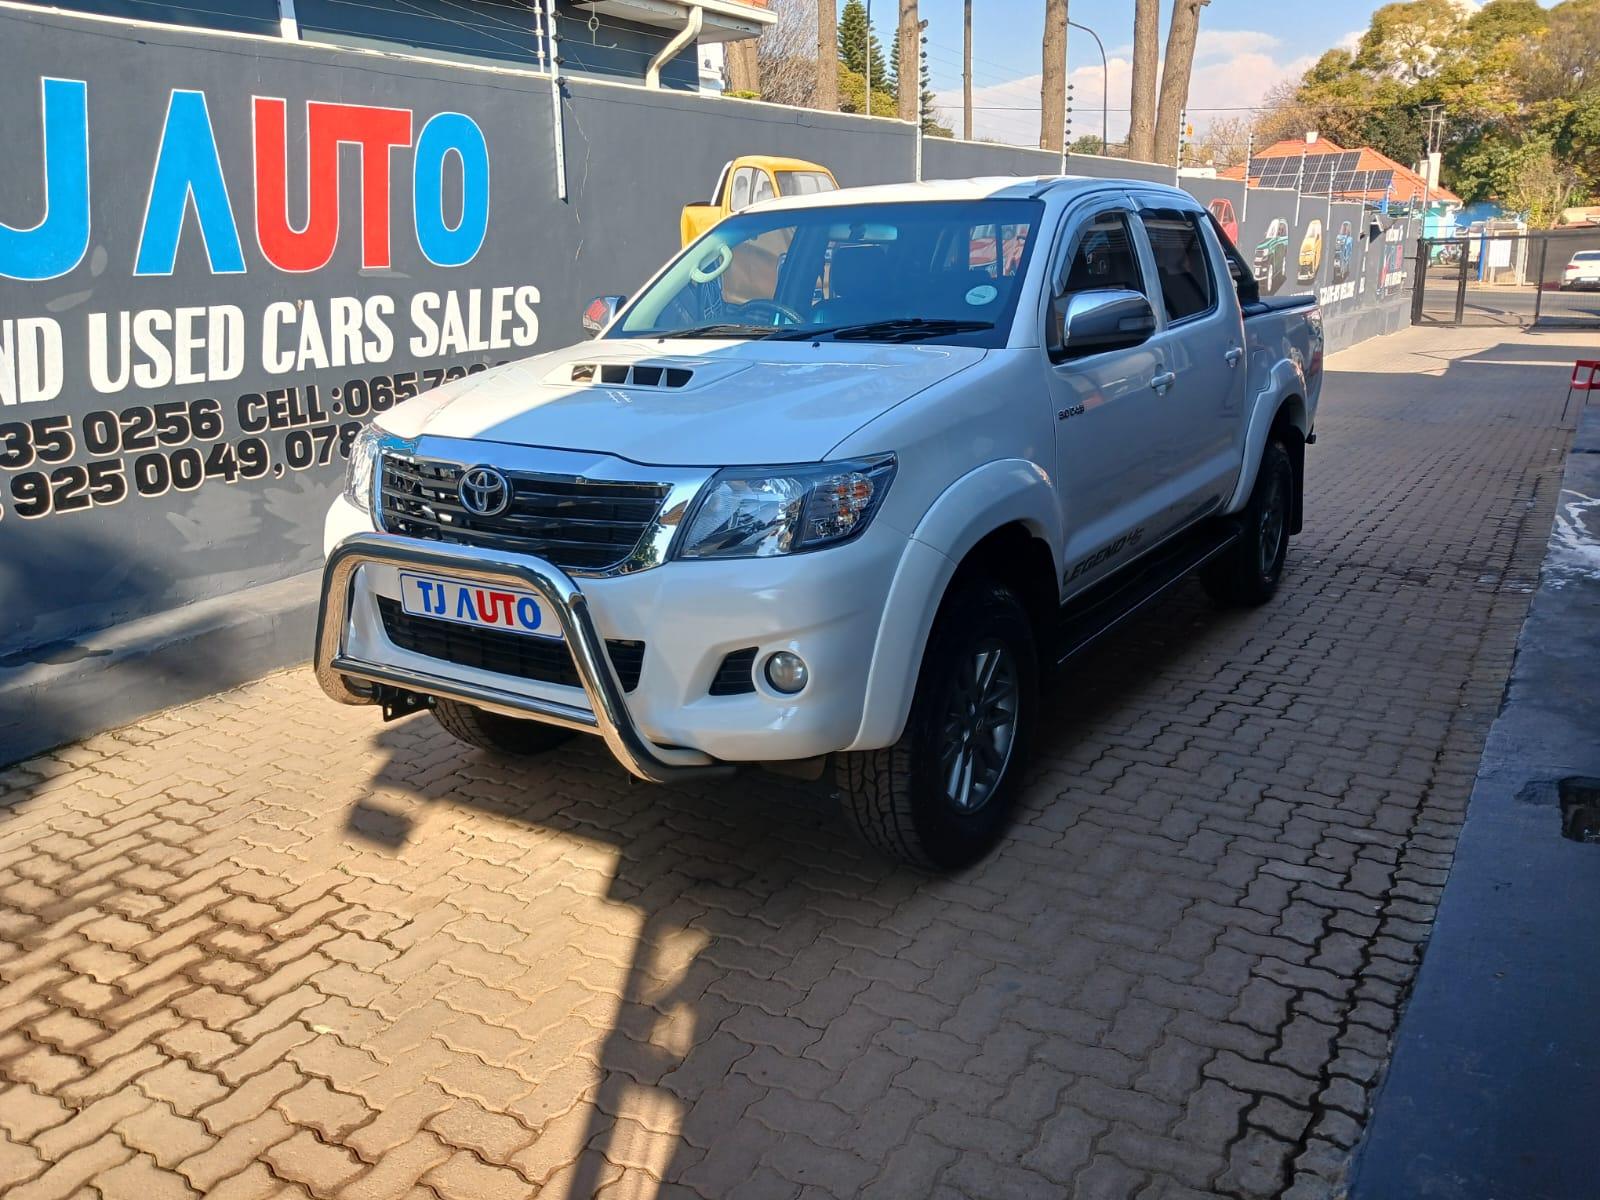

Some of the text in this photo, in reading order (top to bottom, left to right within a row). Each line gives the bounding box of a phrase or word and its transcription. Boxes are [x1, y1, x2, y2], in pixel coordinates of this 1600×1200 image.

[133, 88, 490, 277] AUTO
[89, 304, 246, 394] USED
[261, 295, 395, 373] CARS
[409, 285, 541, 358] SALES
[82, 398, 224, 457] 0256
[9, 458, 128, 520] 925
[416, 580, 542, 630] TJ AUTO
